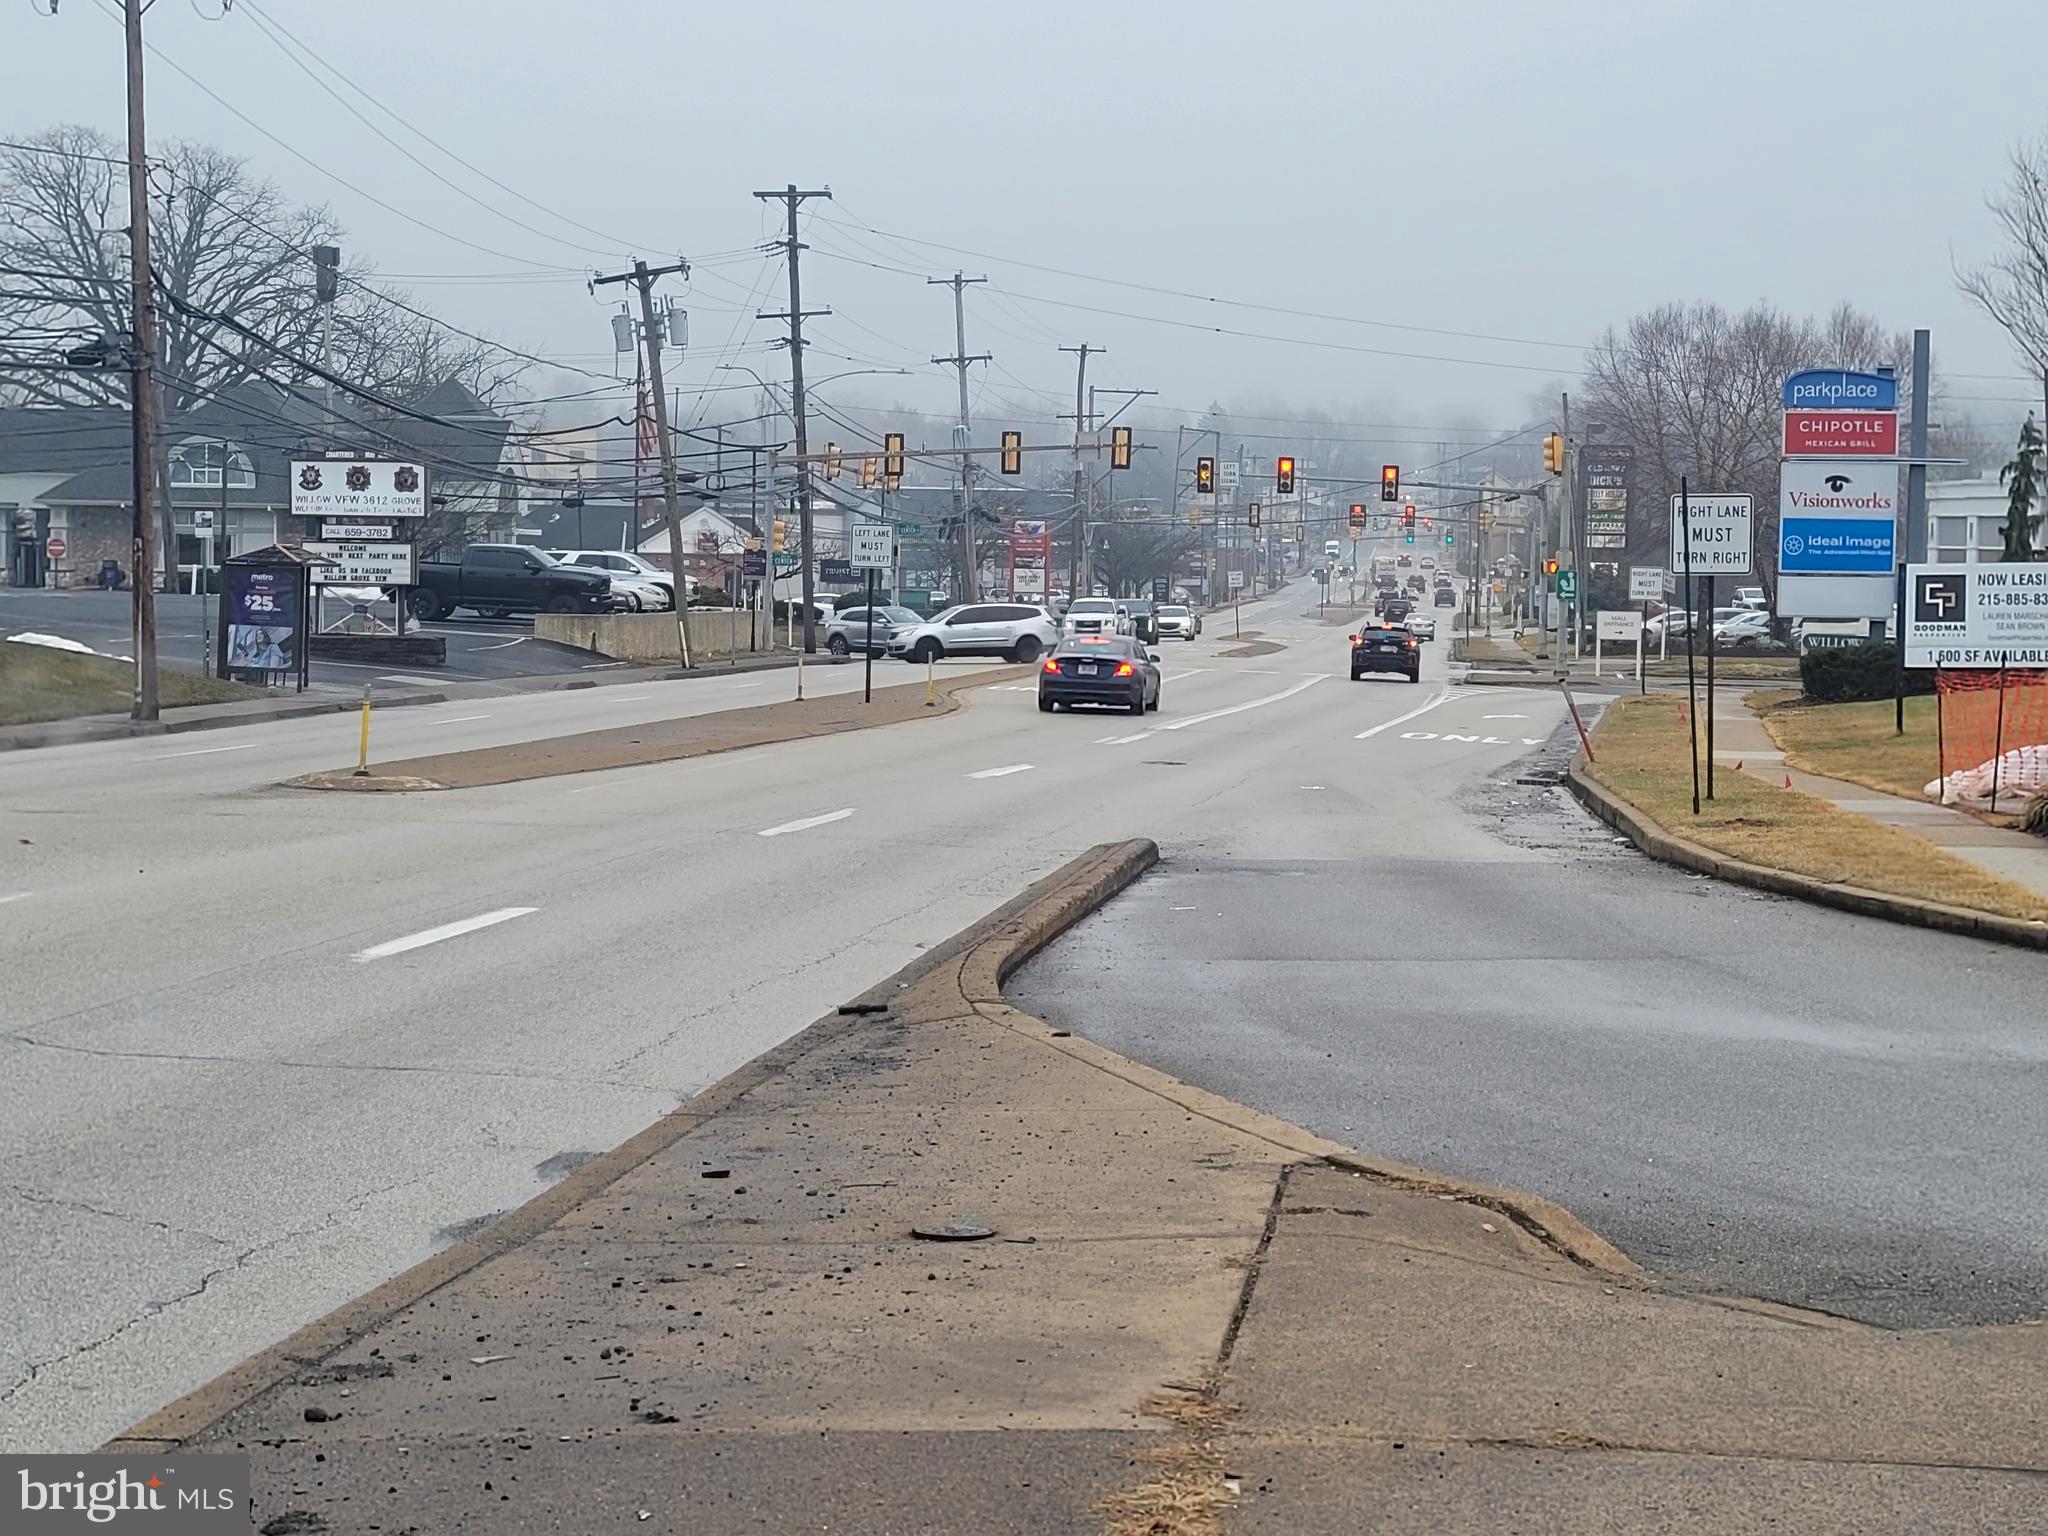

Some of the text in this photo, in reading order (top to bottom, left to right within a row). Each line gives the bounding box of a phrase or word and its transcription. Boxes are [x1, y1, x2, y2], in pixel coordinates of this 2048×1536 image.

[1793, 372, 1878, 405] parkplace
[1799, 420, 1884, 433] CHIPOTLE
[295, 494, 423, 506] WILLOW VFW 3612 GROVE
[1788, 491, 1892, 509] Visionworks
[1677, 505, 1748, 518] RGHT LANE
[344, 528, 389, 537] 659-3782
[854, 529, 890, 538] LEFT LANE
[1692, 527, 1733, 542] MUST
[860, 542, 884, 551] MUST
[348, 552, 364, 560] NEXT
[368, 552, 388, 560] PARTY
[854, 554, 890, 563] TURN LEFT
[1676, 551, 1748, 564] TRN RIGHT
[350, 567, 359, 575] ON
[361, 567, 393, 575] FACEBOOK
[251, 573, 274, 582] metro
[1977, 573, 2047, 586] NOW LEASI
[244, 594, 274, 611] $25
[1978, 593, 2048, 606] 215-885-83
[1914, 624, 1967, 632] GOODMAN
[1808, 636, 1864, 648] WILLOW
[1964, 650, 1980, 662] SF
[1400, 732, 1547, 745] ONLY
